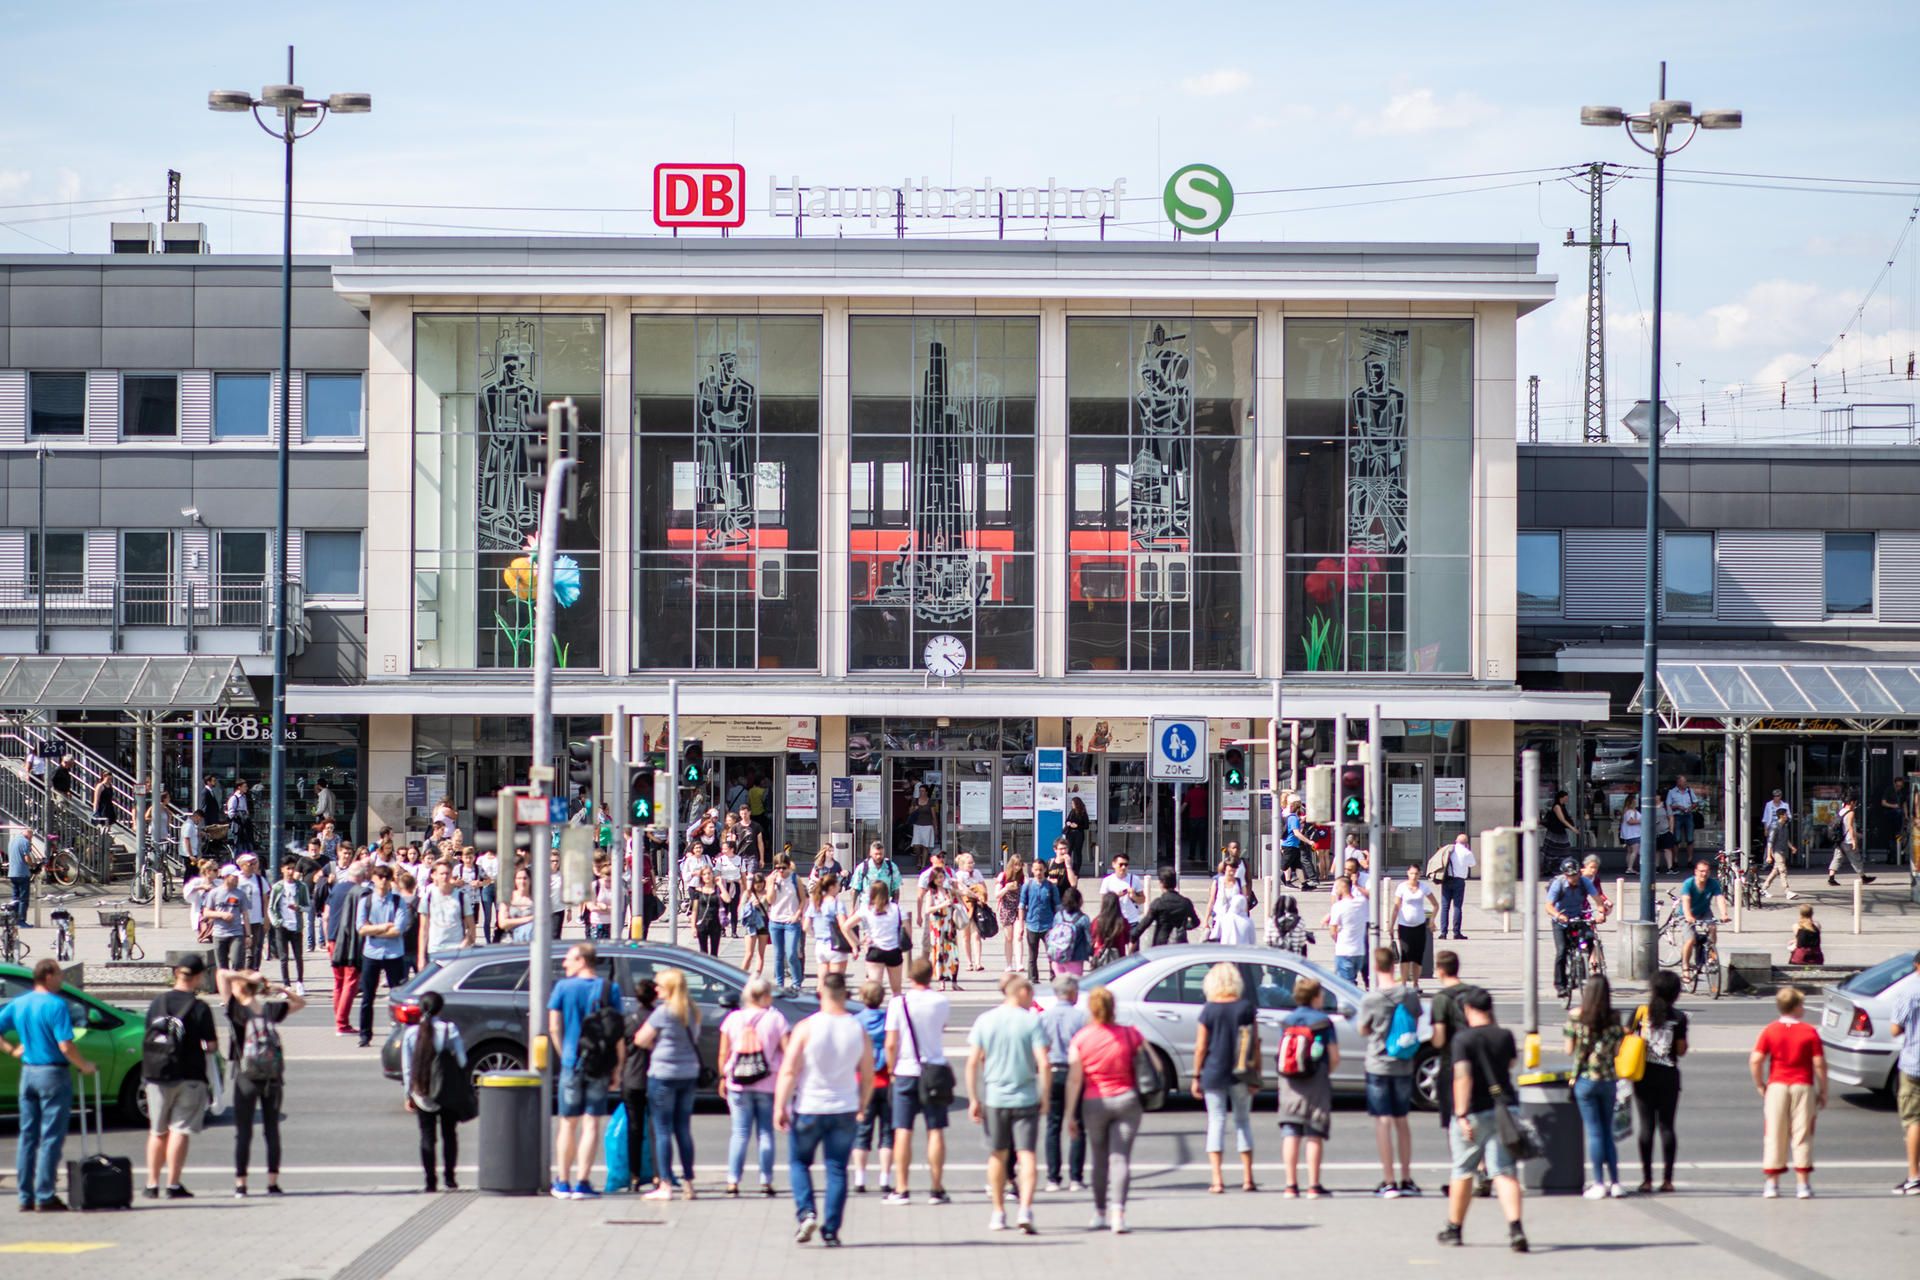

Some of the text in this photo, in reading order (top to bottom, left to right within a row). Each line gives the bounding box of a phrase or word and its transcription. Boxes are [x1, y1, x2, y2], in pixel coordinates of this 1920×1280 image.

[664, 173, 735, 217] DB
[768, 175, 1127, 228] Hauptbahnhof
[1173, 169, 1223, 229] S
[43, 741, 58, 753] 2-5
[262, 728, 297, 740] Bks
[1164, 763, 1193, 776] ZONE
